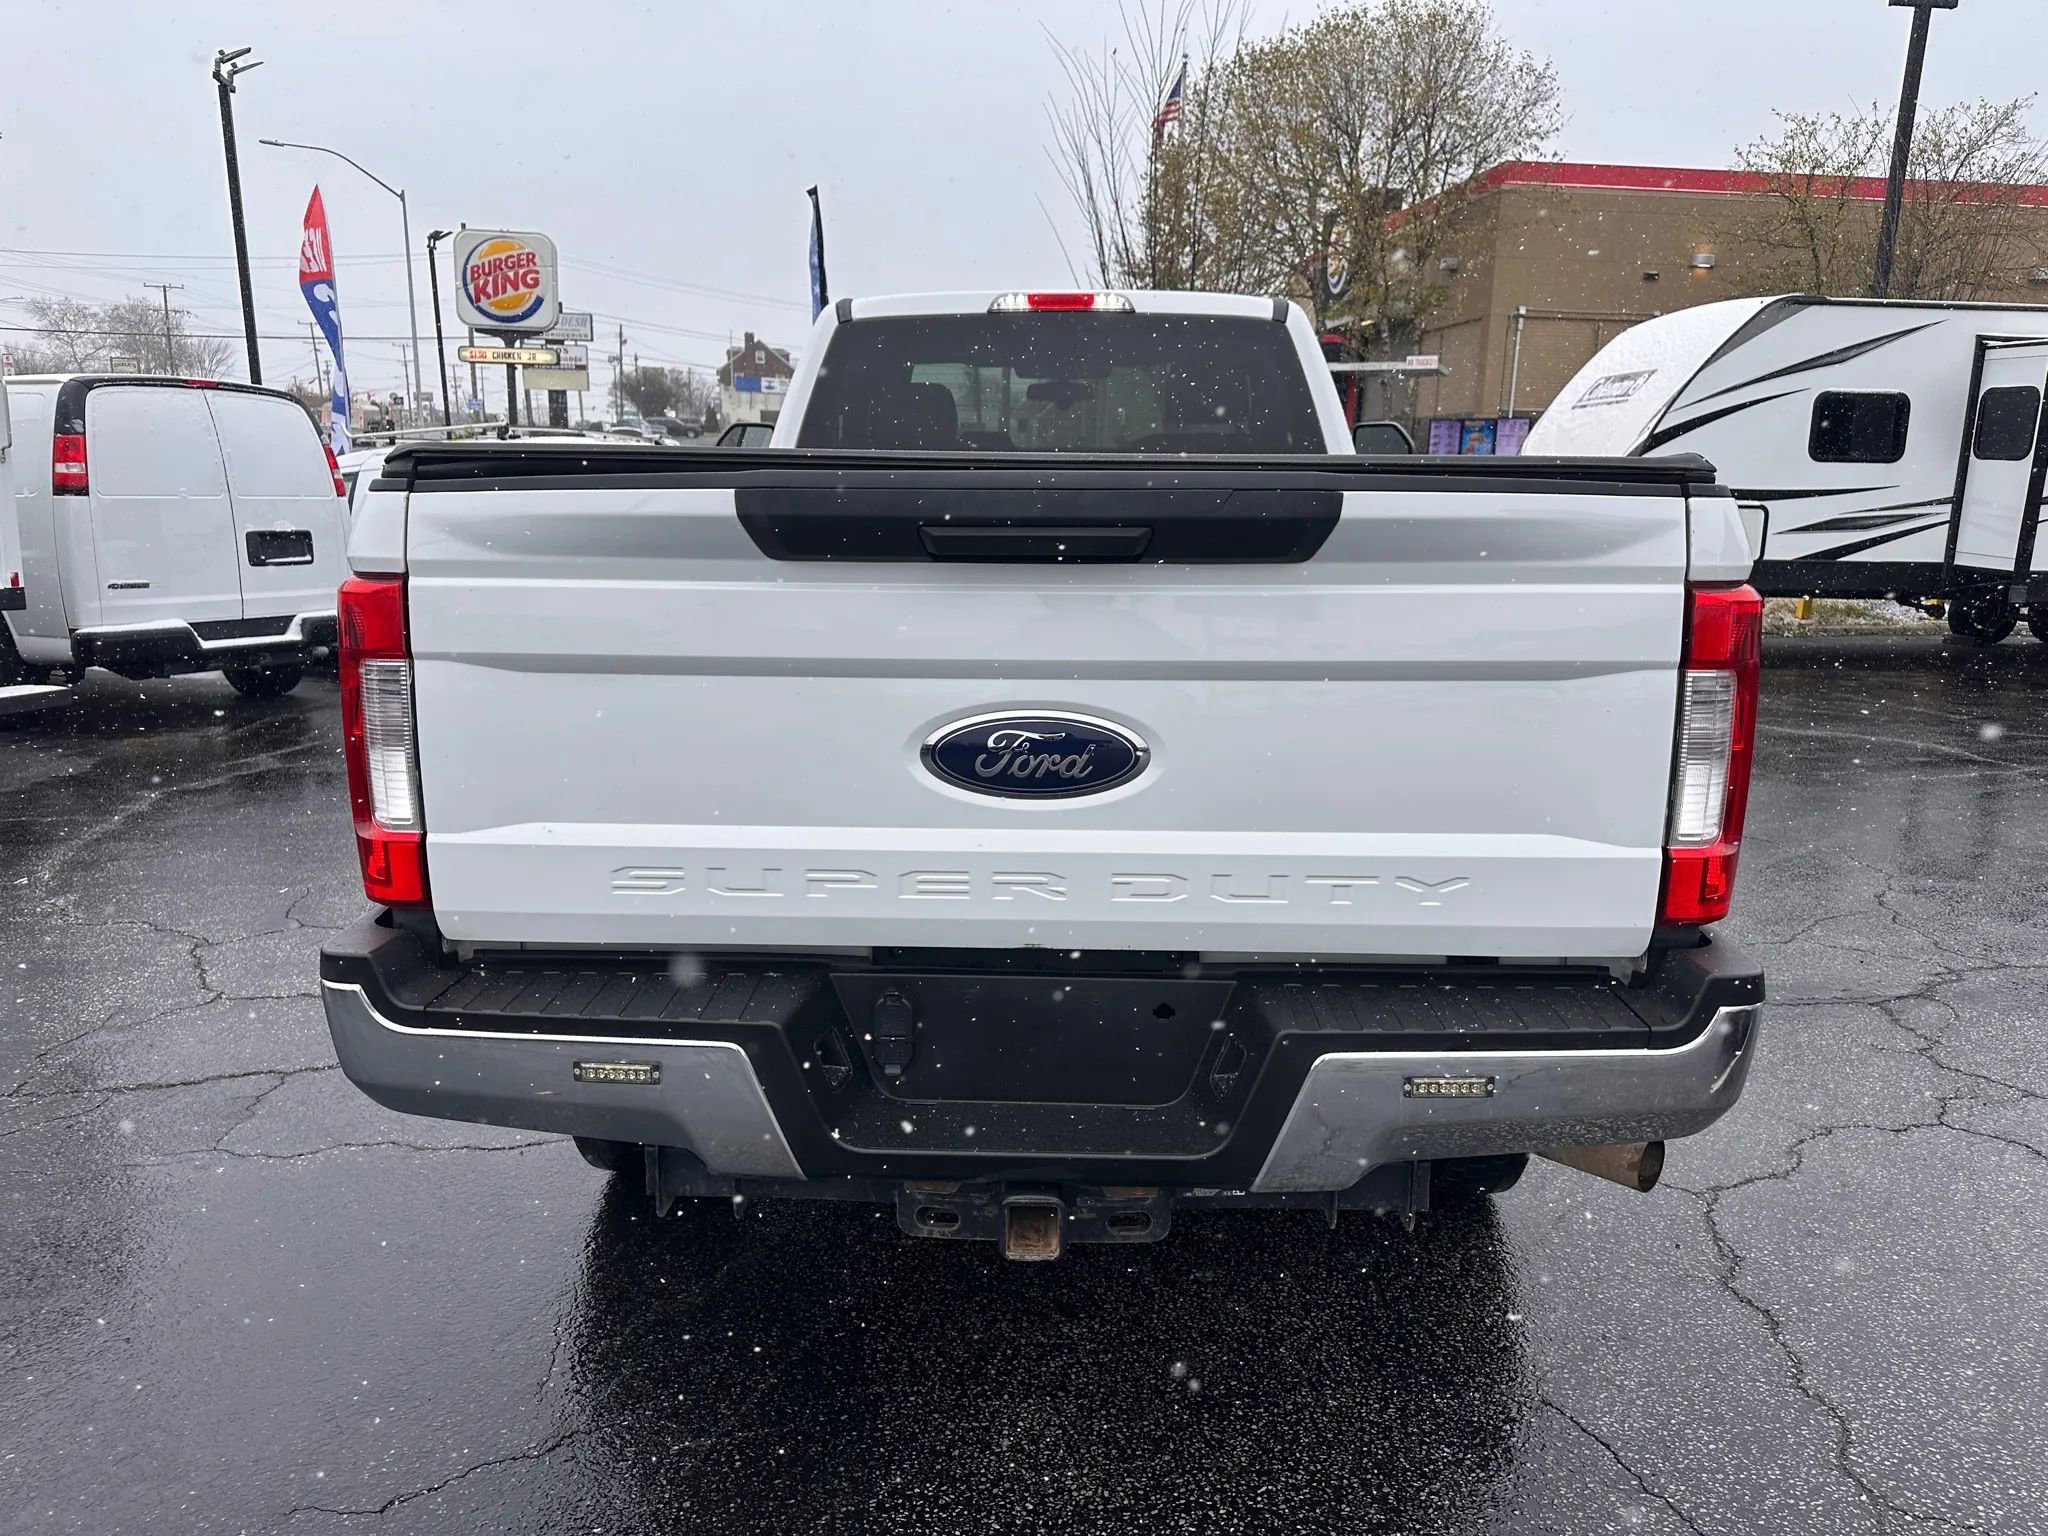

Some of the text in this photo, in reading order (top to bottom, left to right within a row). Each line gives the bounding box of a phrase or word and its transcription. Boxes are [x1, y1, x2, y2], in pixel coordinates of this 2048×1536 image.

[470, 251, 537, 284] BURGER
[473, 269, 540, 304] KING
[492, 351, 522, 361] CHICKEN
[527, 352, 537, 361] JR
[974, 729, 1096, 779] Ford
[611, 865, 1470, 906] SUPER DUTY
